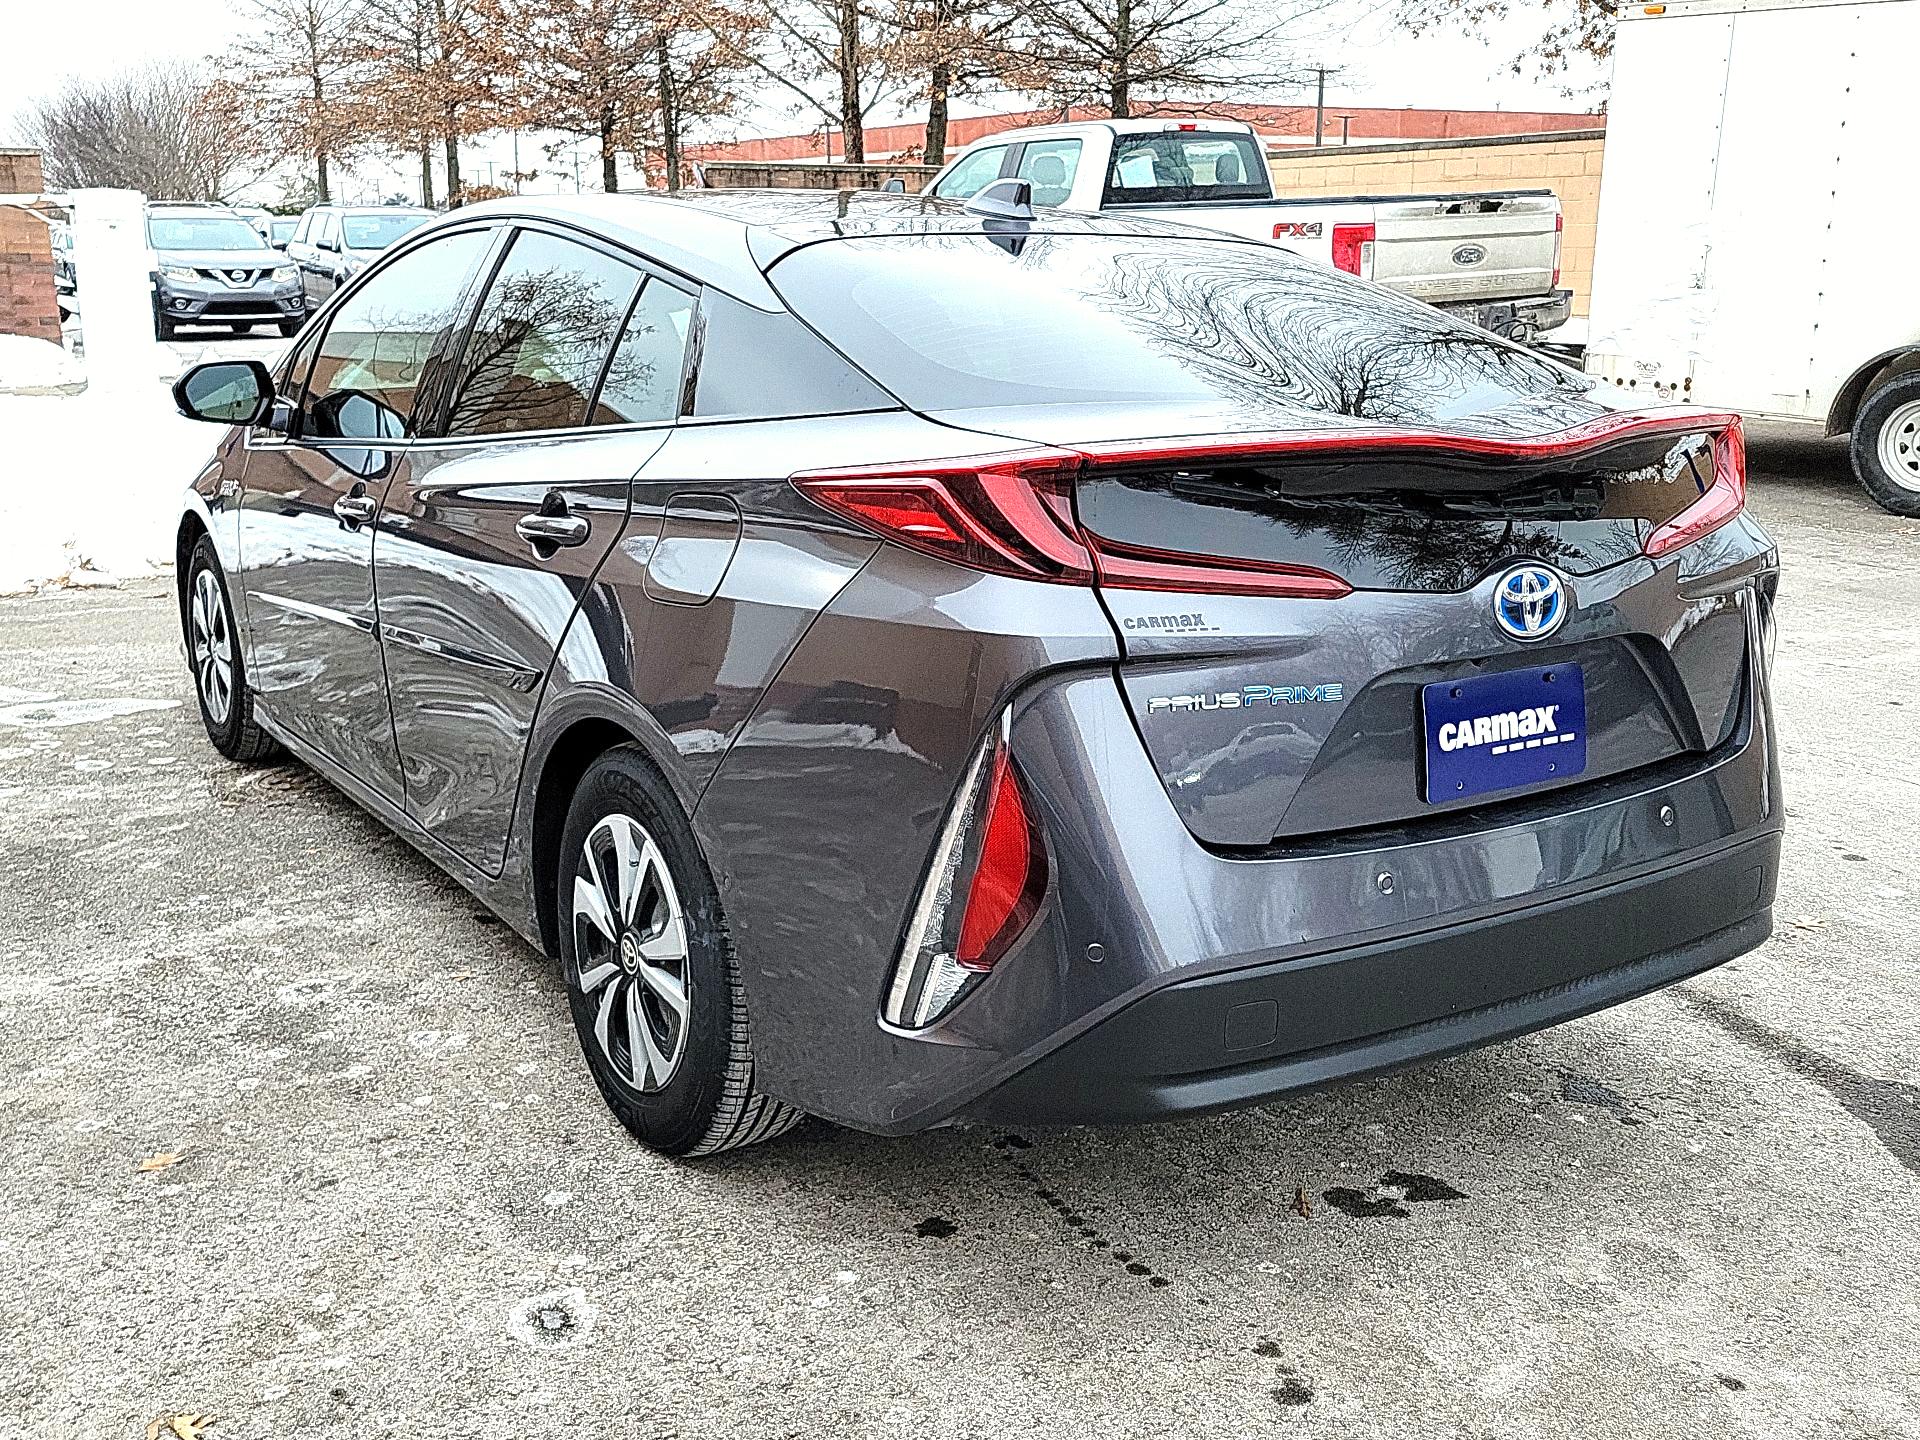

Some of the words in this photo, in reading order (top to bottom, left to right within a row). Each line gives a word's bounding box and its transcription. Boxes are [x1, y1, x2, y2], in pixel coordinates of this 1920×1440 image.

[1272, 222, 1322, 239] FX4
[1147, 691, 1241, 714] PRIUS
[1243, 682, 1343, 708] PRIME
